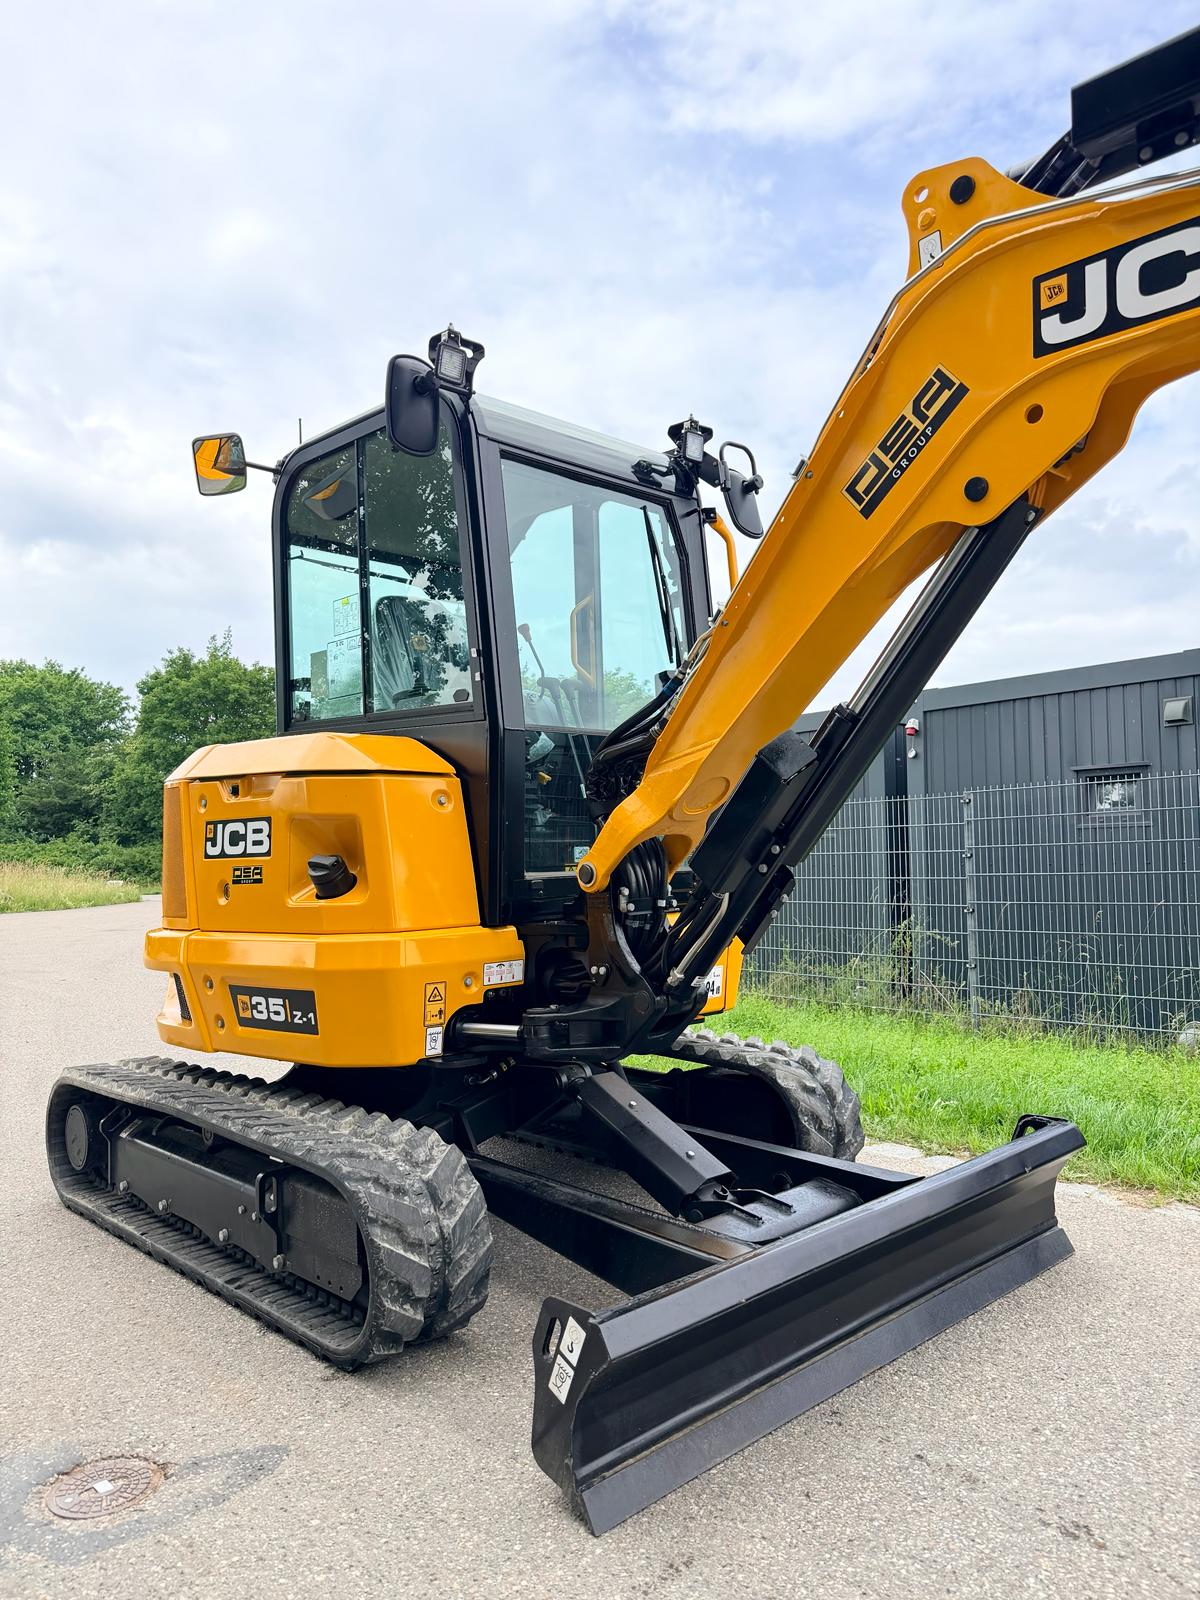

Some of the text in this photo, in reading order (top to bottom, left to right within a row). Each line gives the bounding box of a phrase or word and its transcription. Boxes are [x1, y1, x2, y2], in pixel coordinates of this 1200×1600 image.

[1047, 284, 1063, 300] JCB
[892, 426, 933, 479] GROUP
[206, 820, 270, 856] JCB
[251, 995, 286, 1022] 35
[292, 1010, 316, 1025] Z-1
